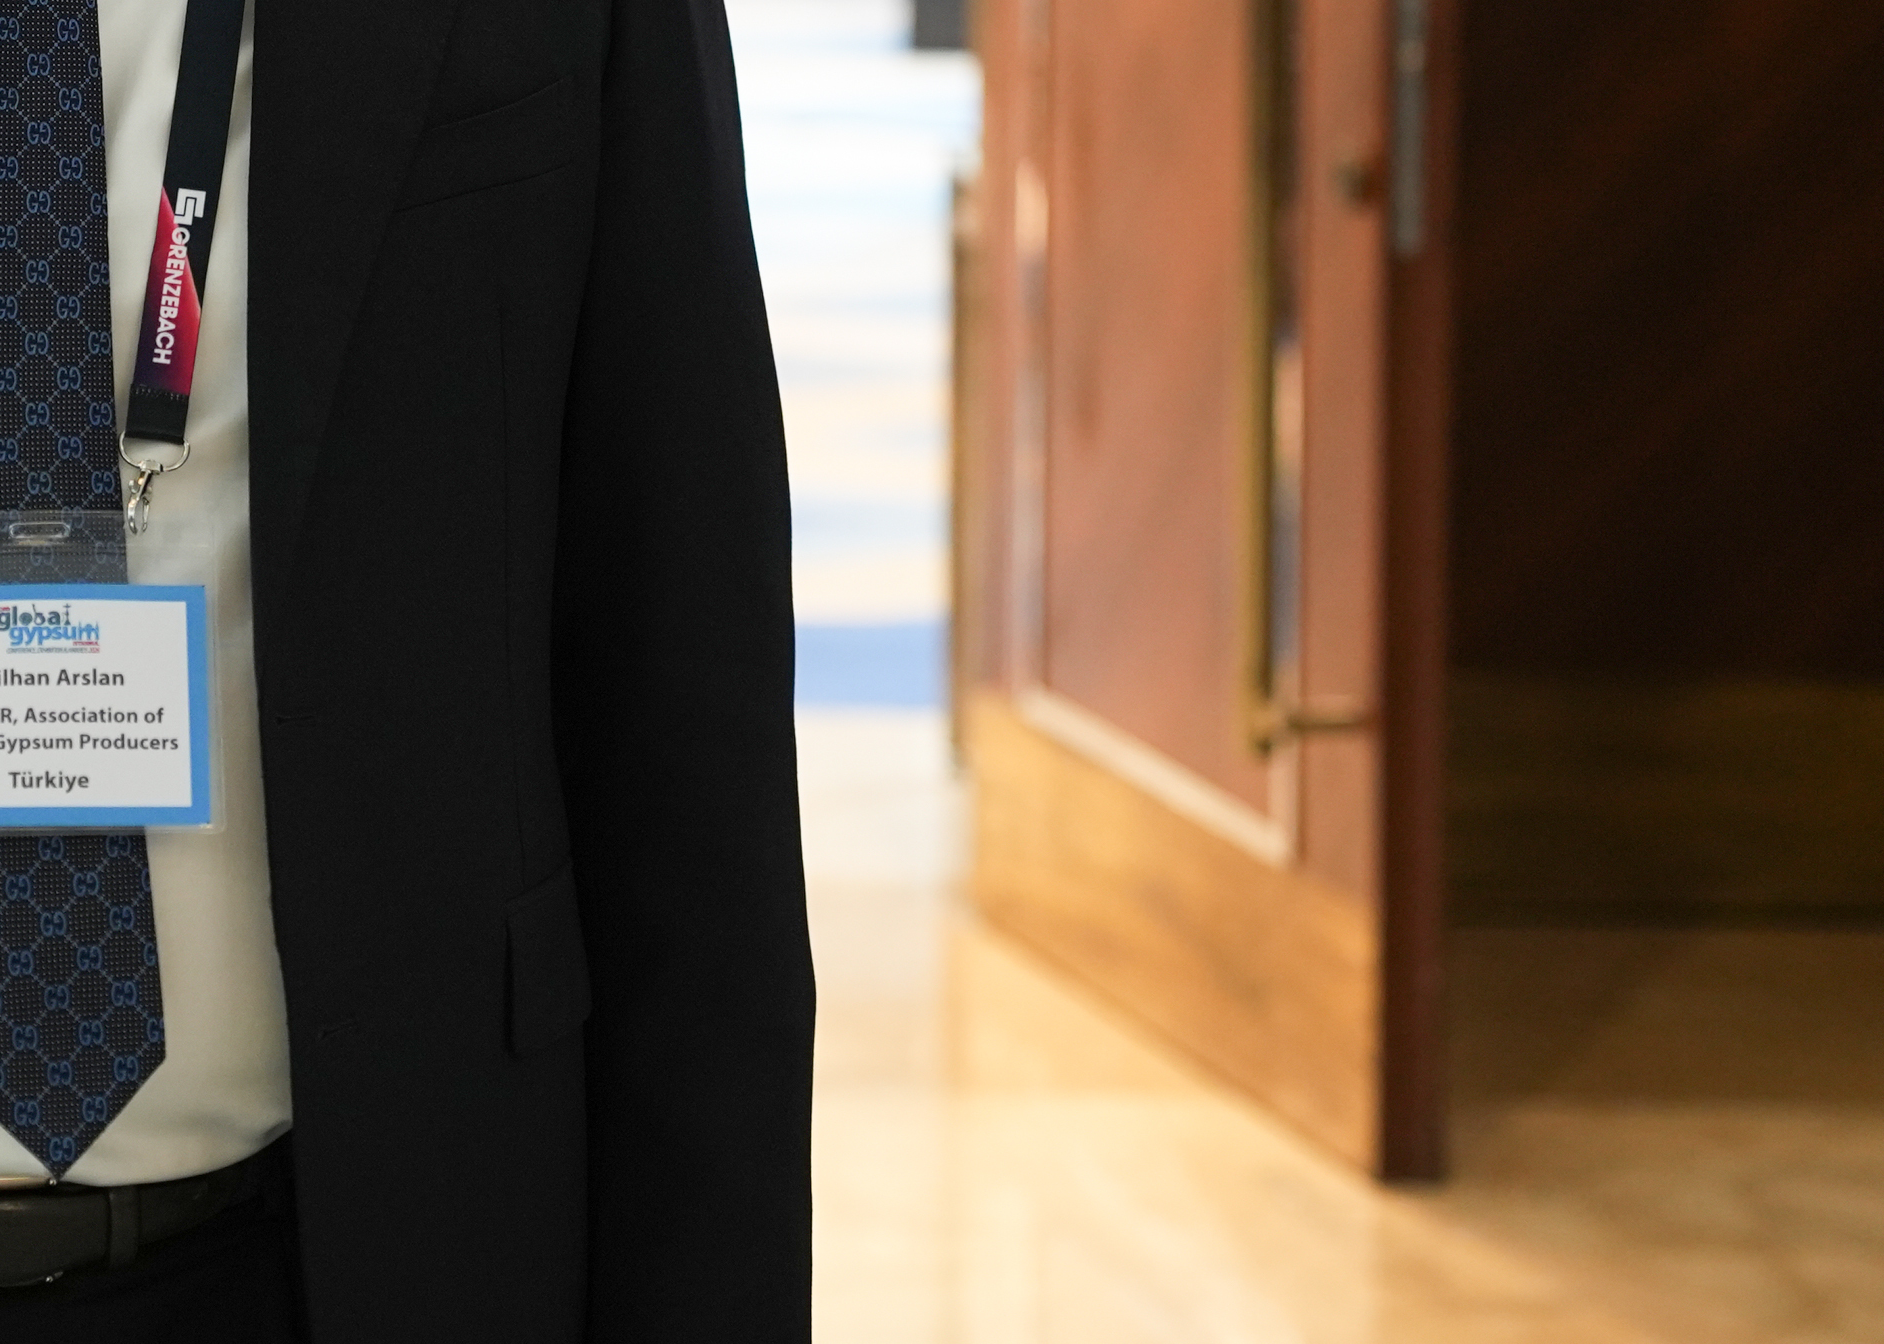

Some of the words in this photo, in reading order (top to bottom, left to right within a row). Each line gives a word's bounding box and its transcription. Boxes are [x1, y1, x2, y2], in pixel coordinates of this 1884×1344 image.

[152, 227, 191, 365] GRENZEBACH
[9, 621, 100, 646] gypsum
[56, 668, 125, 687] Arslan
[24, 707, 138, 724] Association
[144, 708, 164, 724] of
[79, 733, 179, 751] Producers
[8, 771, 90, 793] Türkiye
